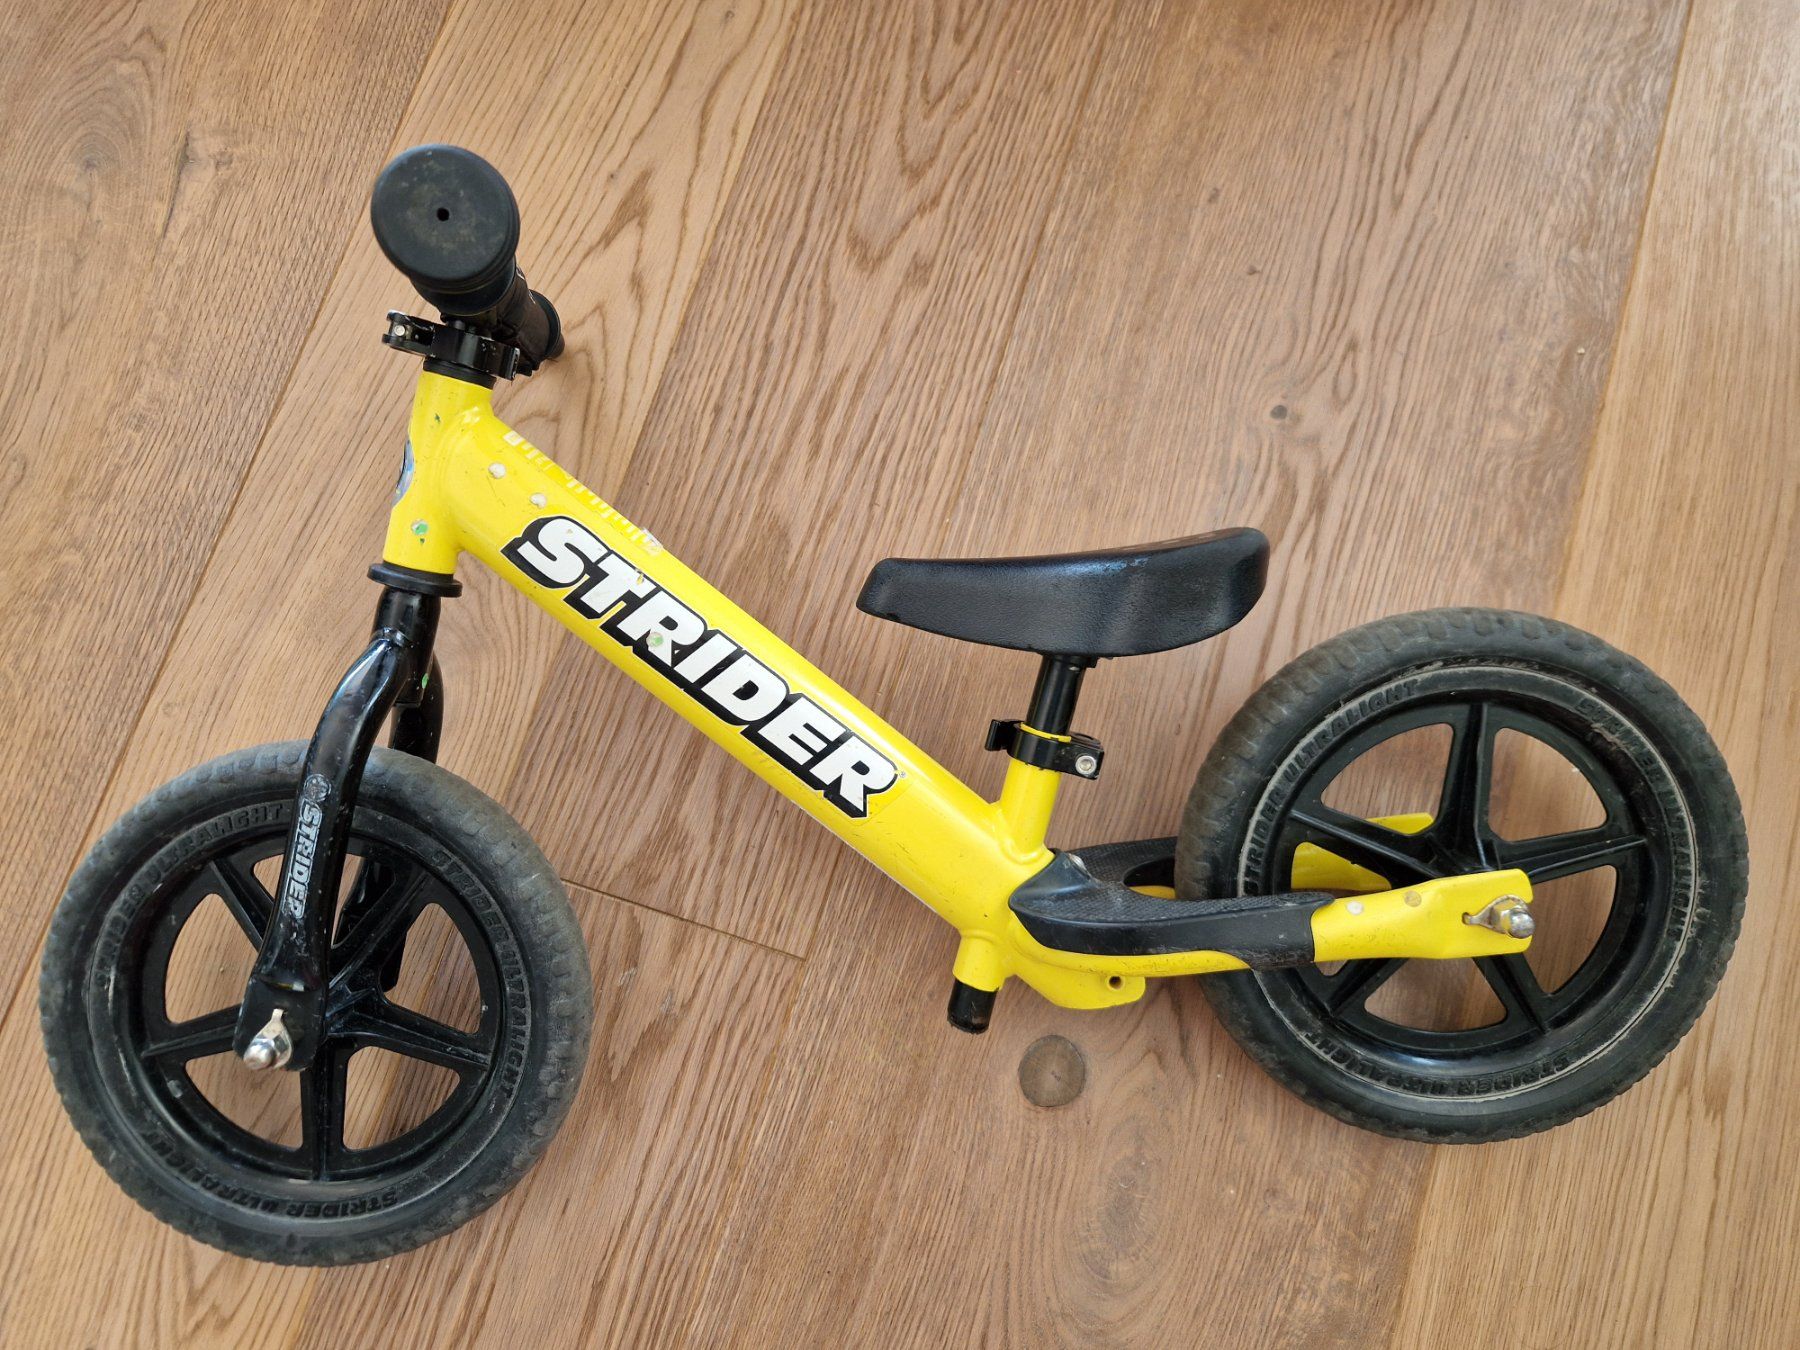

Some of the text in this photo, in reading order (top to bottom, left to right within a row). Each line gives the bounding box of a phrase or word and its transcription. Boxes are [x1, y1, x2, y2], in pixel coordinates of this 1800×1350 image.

[501, 516, 899, 818] STRIDER
[1283, 678, 1418, 784] ULTRALIGHT
[149, 803, 283, 884] ULTRALIGHT
[432, 850, 528, 1099] STRIDER ULTRALIGHT
[286, 1184, 401, 1218] STRIDER
